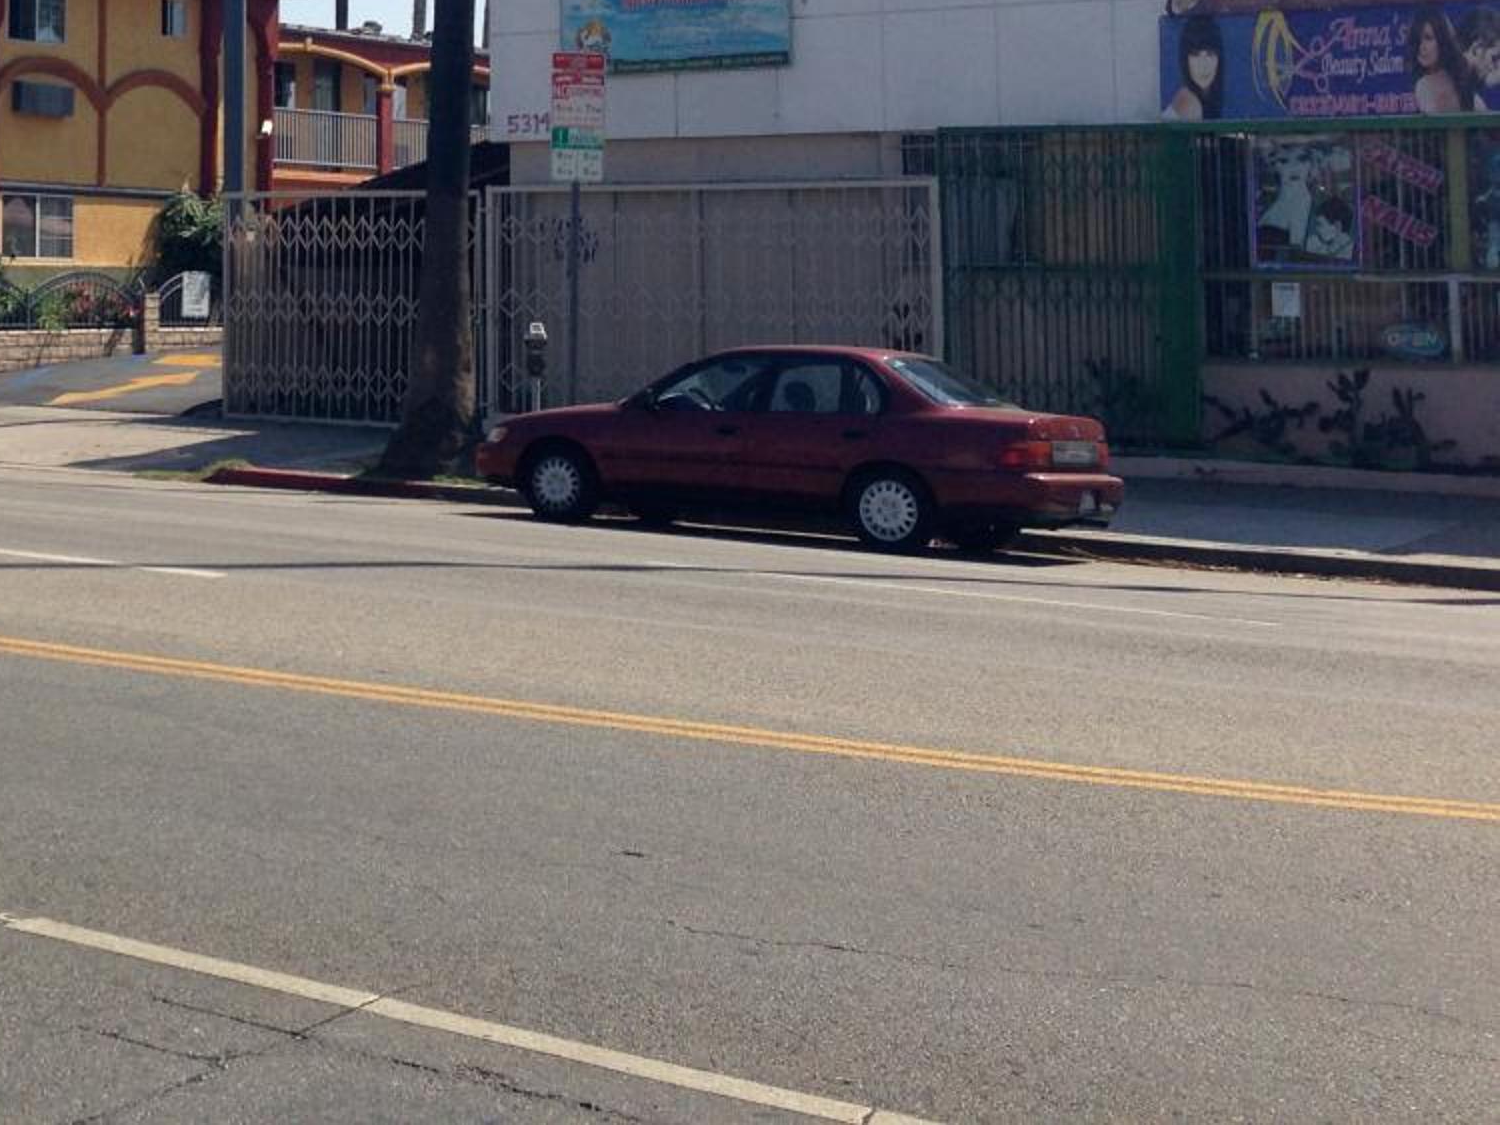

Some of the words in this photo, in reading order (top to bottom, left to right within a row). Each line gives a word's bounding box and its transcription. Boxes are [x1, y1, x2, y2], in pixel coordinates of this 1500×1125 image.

[1330, 13, 1411, 49] Anna's
[1321, 56, 1367, 83] Beauty
[1368, 48, 1406, 75] Salon
